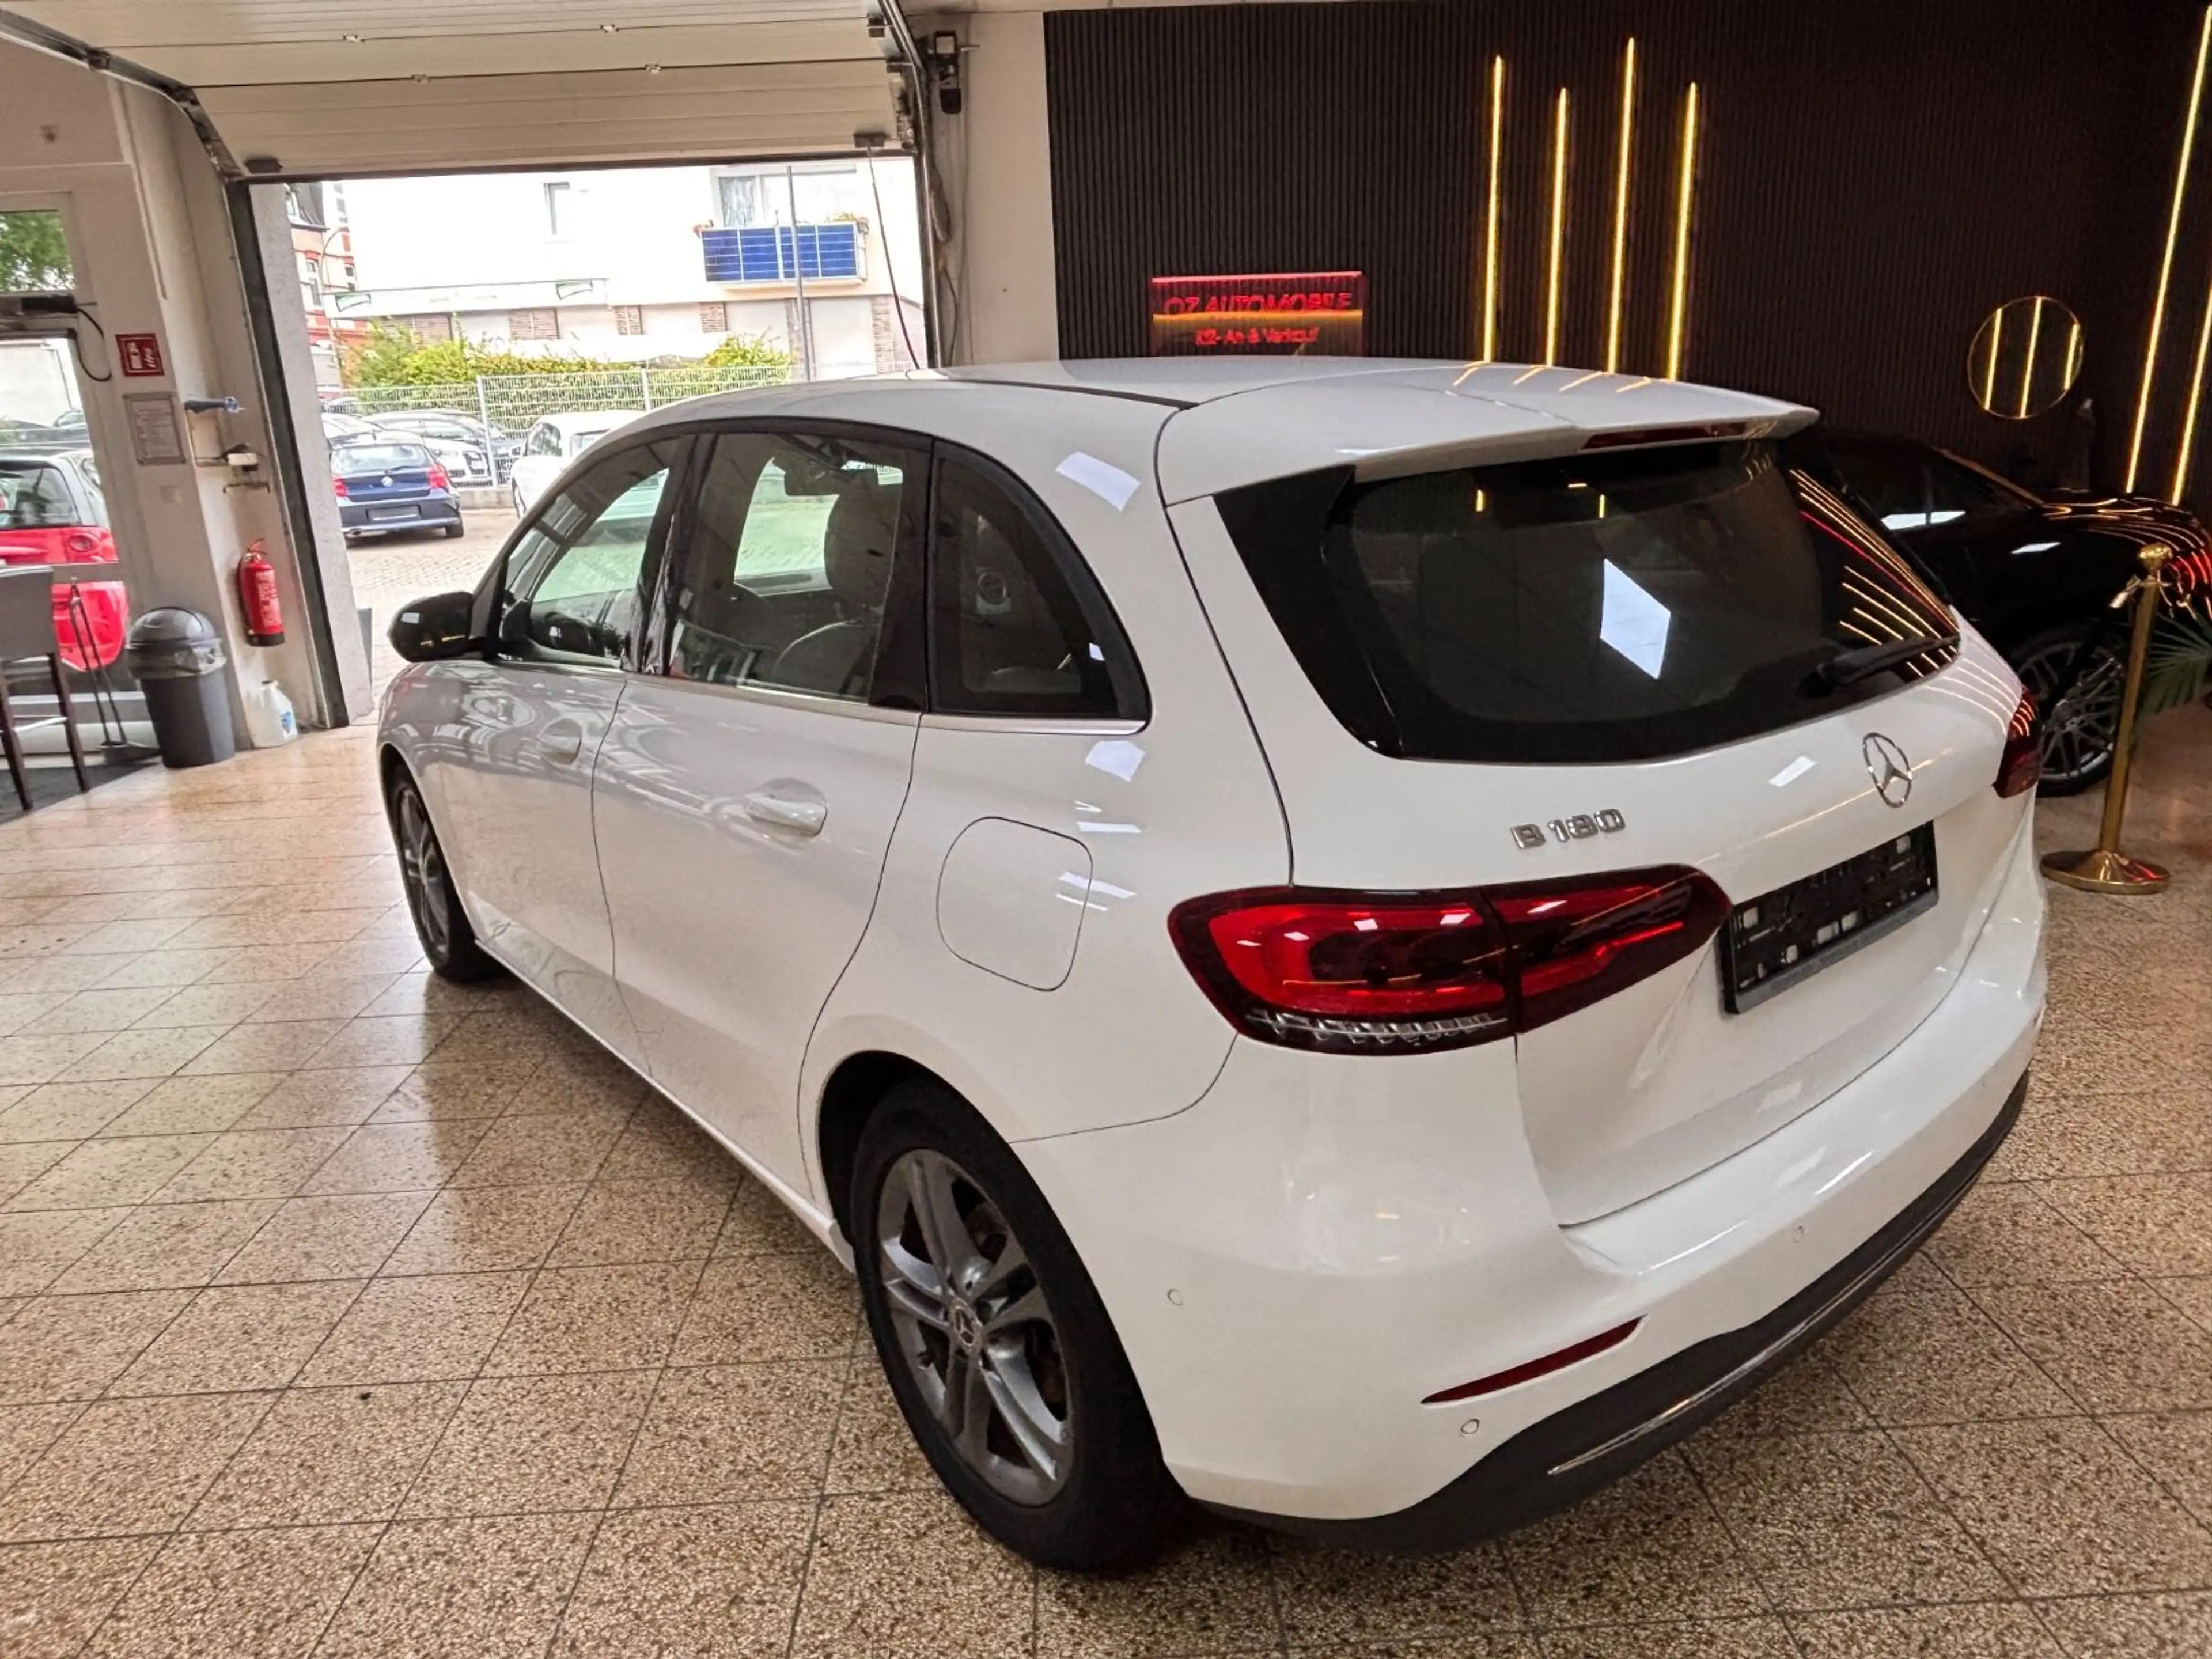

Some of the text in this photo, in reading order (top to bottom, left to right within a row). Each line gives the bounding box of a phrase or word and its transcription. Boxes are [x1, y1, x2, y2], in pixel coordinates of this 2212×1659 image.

[1205, 293, 1351, 312] AUTOMOBILE
[1509, 808, 1626, 850] B 180
